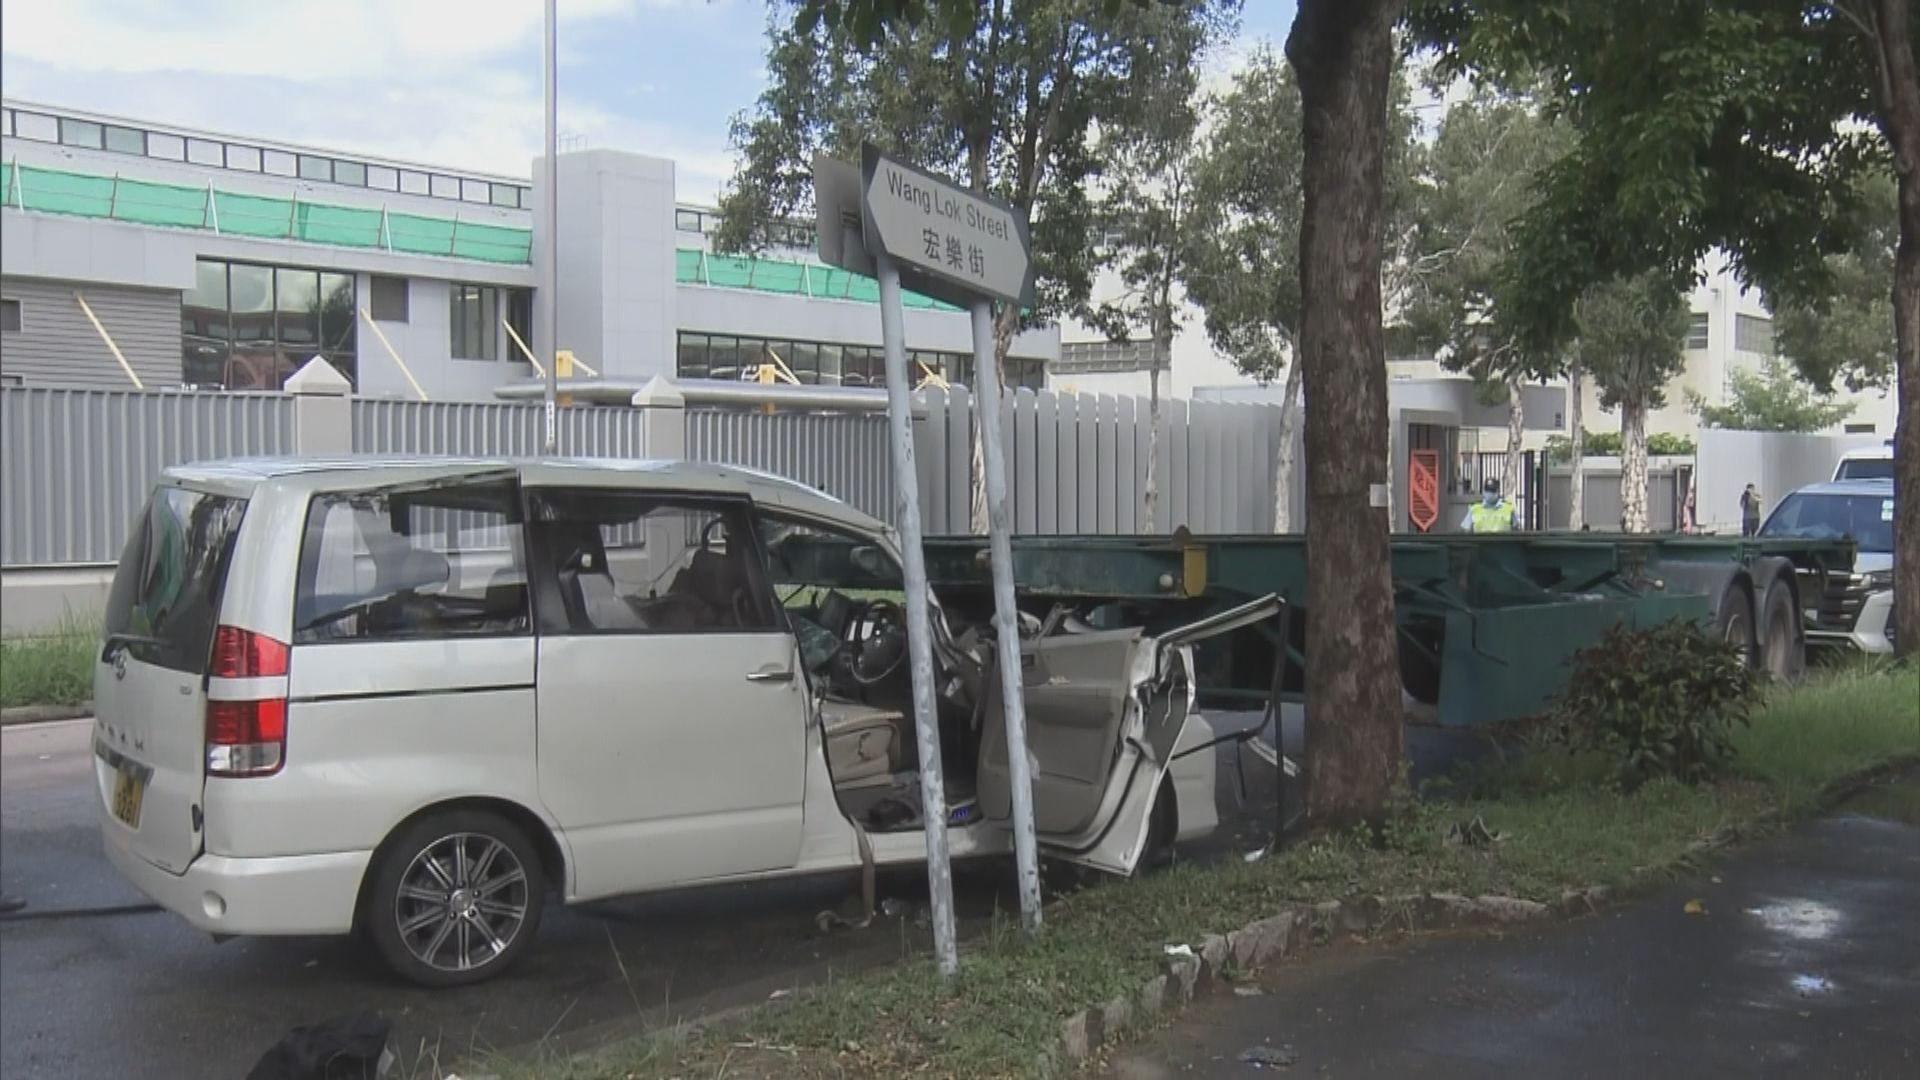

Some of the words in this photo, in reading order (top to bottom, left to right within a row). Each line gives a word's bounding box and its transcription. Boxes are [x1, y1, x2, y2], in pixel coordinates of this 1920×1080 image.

[886, 167, 930, 215] Wang
[935, 186, 961, 222] Lok
[966, 203, 1009, 241] Street
[922, 226, 985, 279] 宏樂街
